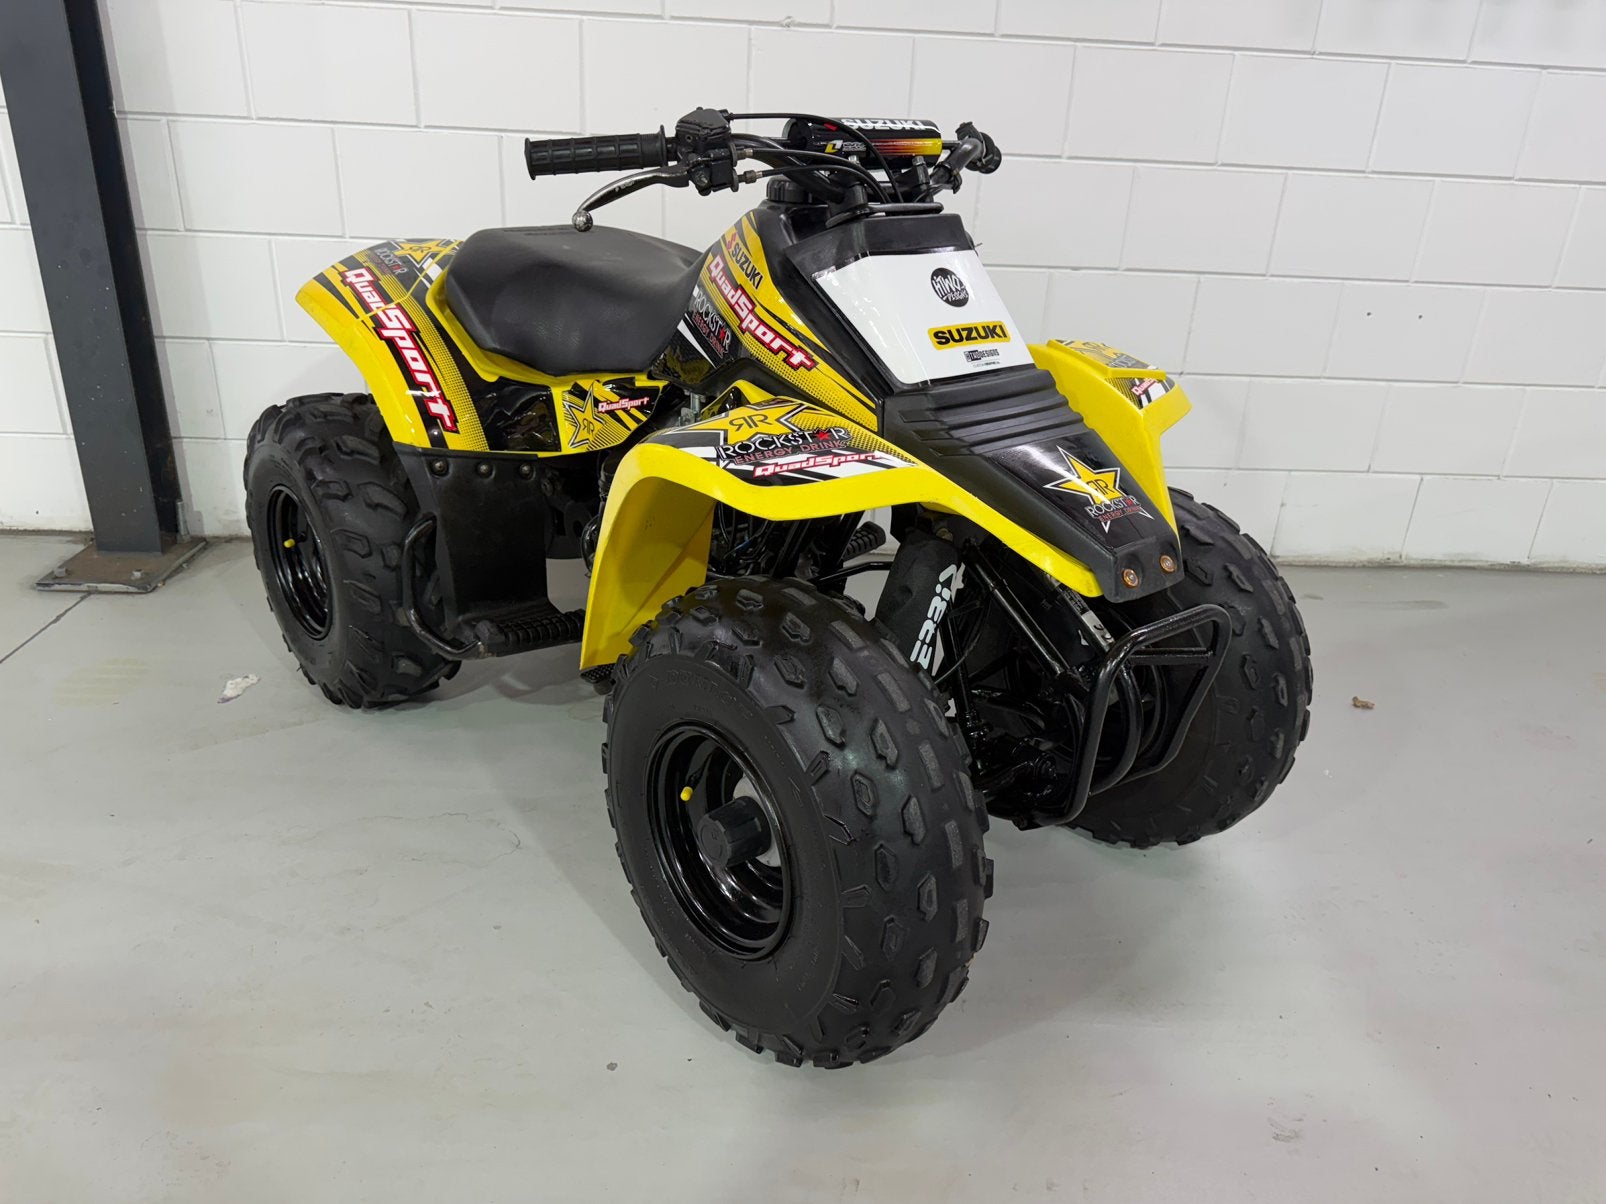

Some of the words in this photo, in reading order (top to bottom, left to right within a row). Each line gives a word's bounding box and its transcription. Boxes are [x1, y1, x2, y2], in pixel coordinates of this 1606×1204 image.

[841, 119, 927, 130] SUZUKI
[732, 243, 763, 290] SUZUKI
[708, 255, 815, 370] QuadSport
[933, 324, 1007, 346] SUZUKI
[341, 267, 457, 431] QuadSport
[597, 397, 650, 414] QuadSport
[735, 446, 793, 464] ENERGY
[801, 440, 845, 454] DRINK
[753, 452, 886, 477] QuadSport
